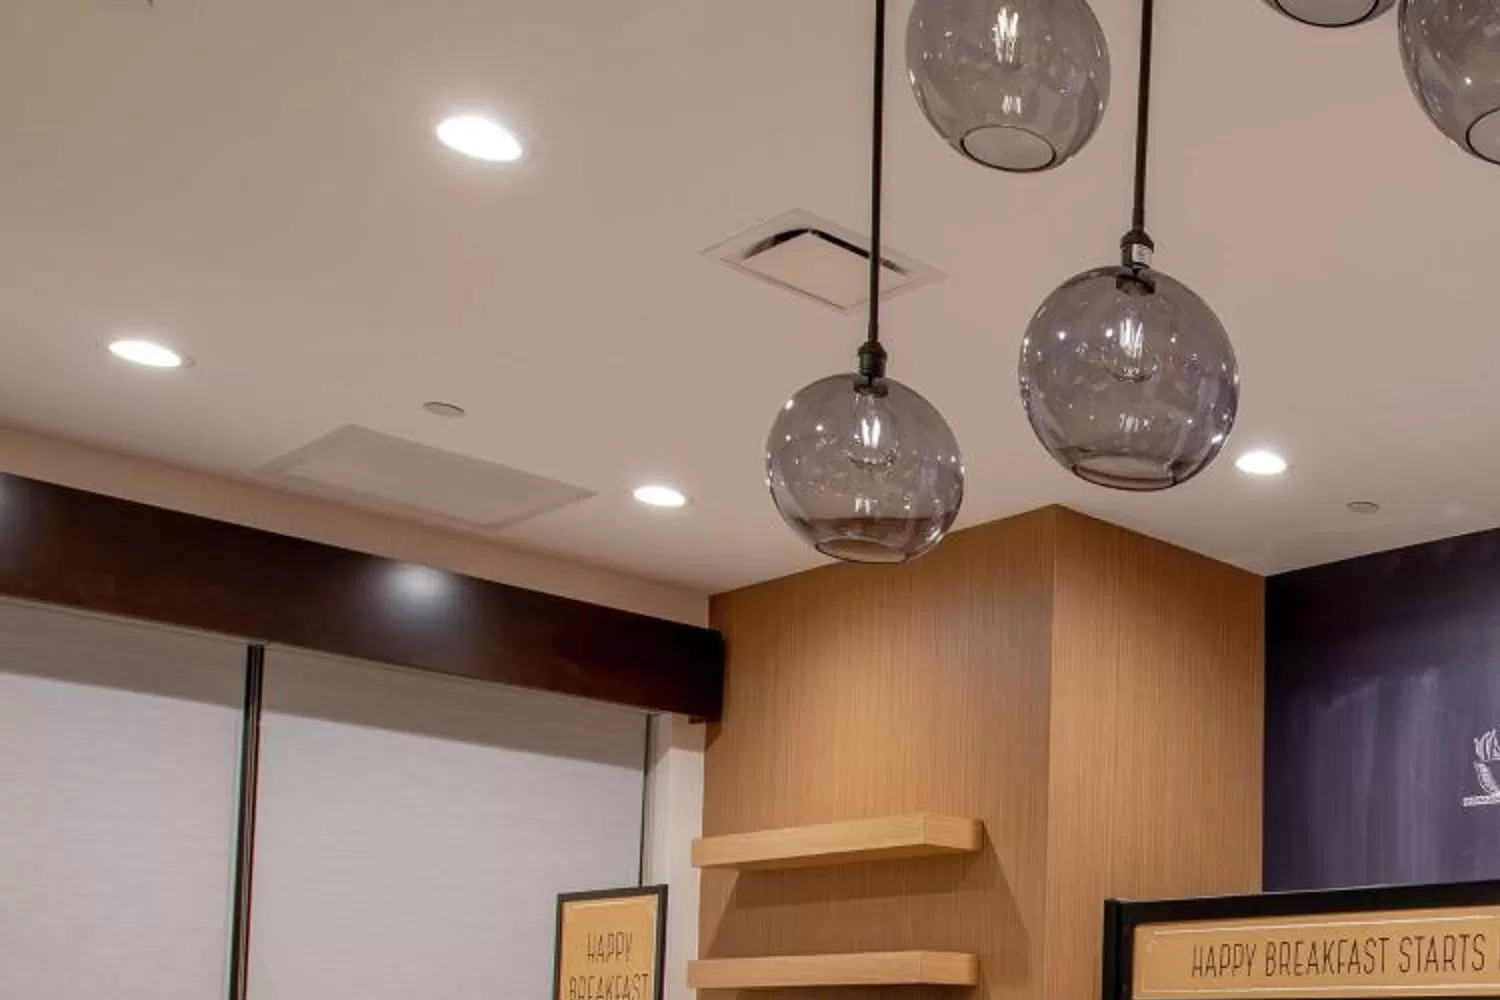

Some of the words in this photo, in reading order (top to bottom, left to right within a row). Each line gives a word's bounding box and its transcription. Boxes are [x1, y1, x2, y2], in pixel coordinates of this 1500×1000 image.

[586, 931, 633, 964] HAPPY
[1191, 943, 1257, 977] HAPPY
[1264, 937, 1390, 978] BREAKFAST
[1399, 933, 1486, 973] STARTS
